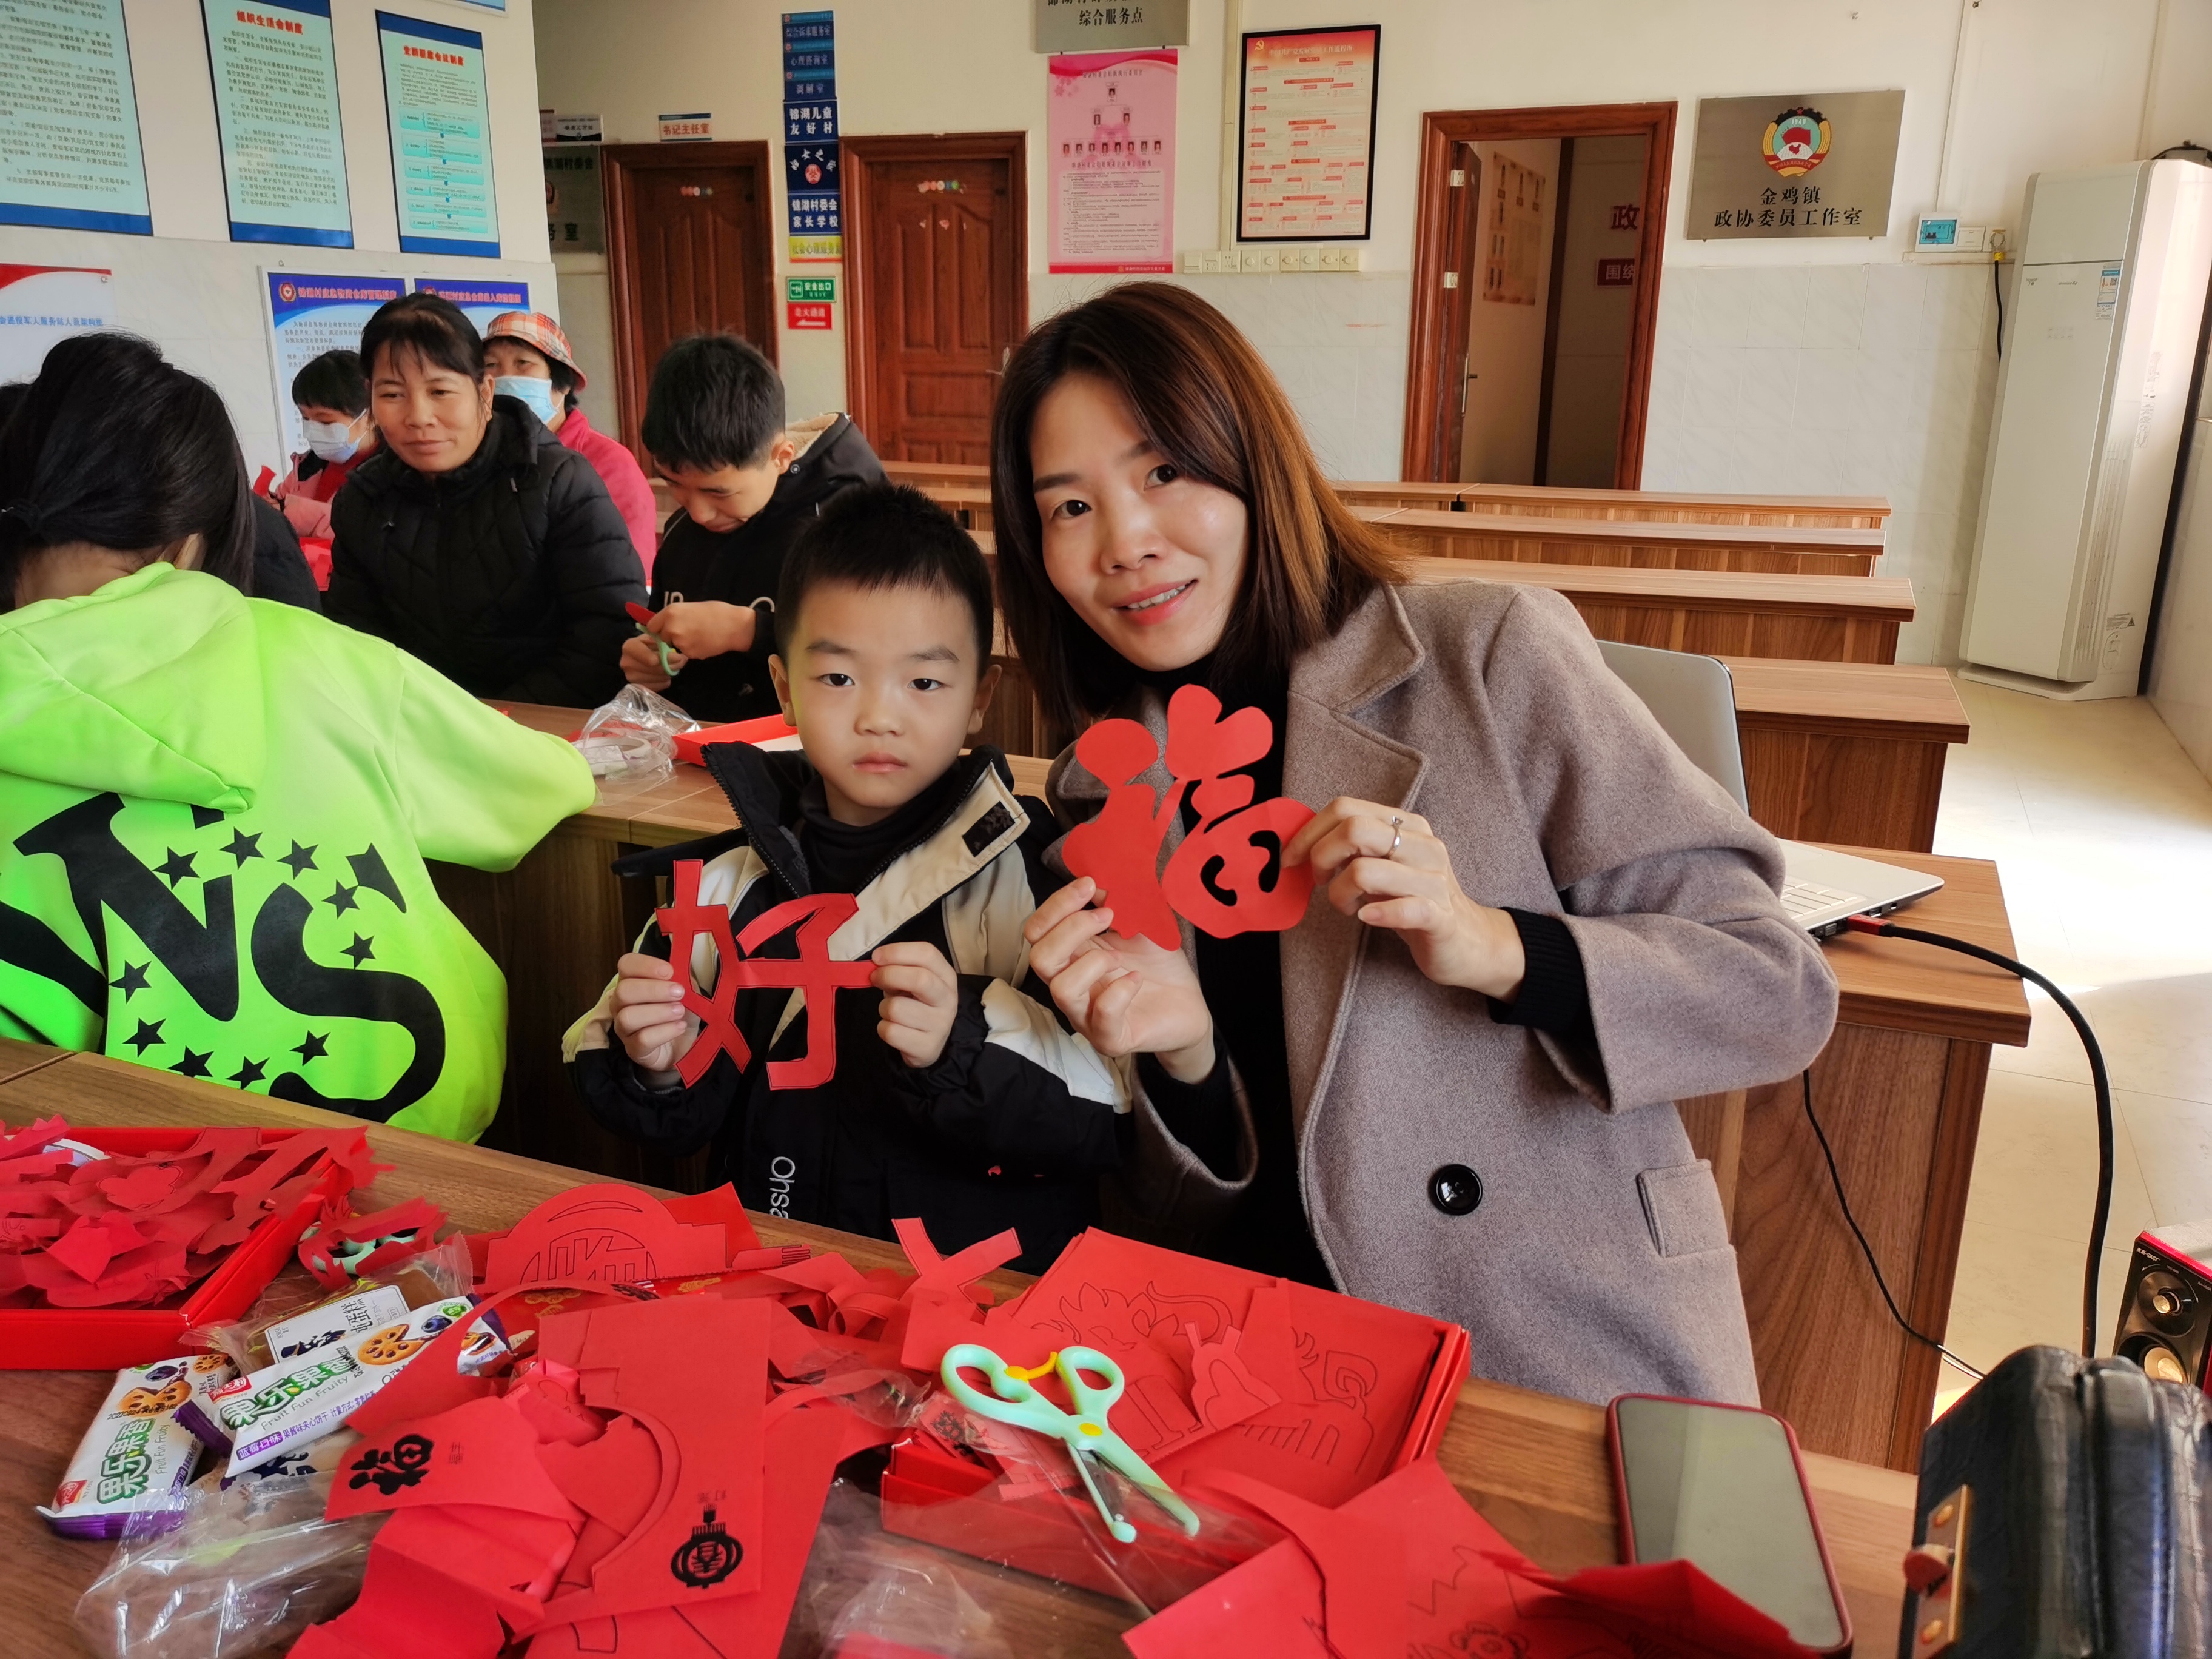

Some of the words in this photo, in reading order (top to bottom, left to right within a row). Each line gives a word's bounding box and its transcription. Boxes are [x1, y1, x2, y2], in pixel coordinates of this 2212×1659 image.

[1079, 7, 1143, 26] 综合服务点
[789, 107, 833, 120] 锦湖儿童
[663, 122, 710, 136] 书记主任室
[790, 121, 833, 135] 友好村
[790, 149, 837, 172] 妇女之家
[791, 199, 837, 212] 锦湖村委会
[1760, 186, 1821, 206] 金鸡镇
[793, 215, 838, 228] 家长学校
[1610, 204, 1640, 231] 政
[1714, 207, 1863, 227] 政协委员工作室
[804, 283, 831, 291] 安全出口
[1062, 683, 1318, 951] 福
[655, 859, 877, 1090] 好
[261, 1408, 289, 1431] Fruit
[292, 1397, 313, 1411] Fun
[317, 1376, 349, 1397] Fruity
[155, 1424, 171, 1443] Fruity
[283, 1411, 329, 1439] 果酱味夹心饼干
[154, 1442, 166, 1457] Fun
[238, 1433, 283, 1459] 蓝莓口味
[156, 1455, 167, 1475] Fruit
